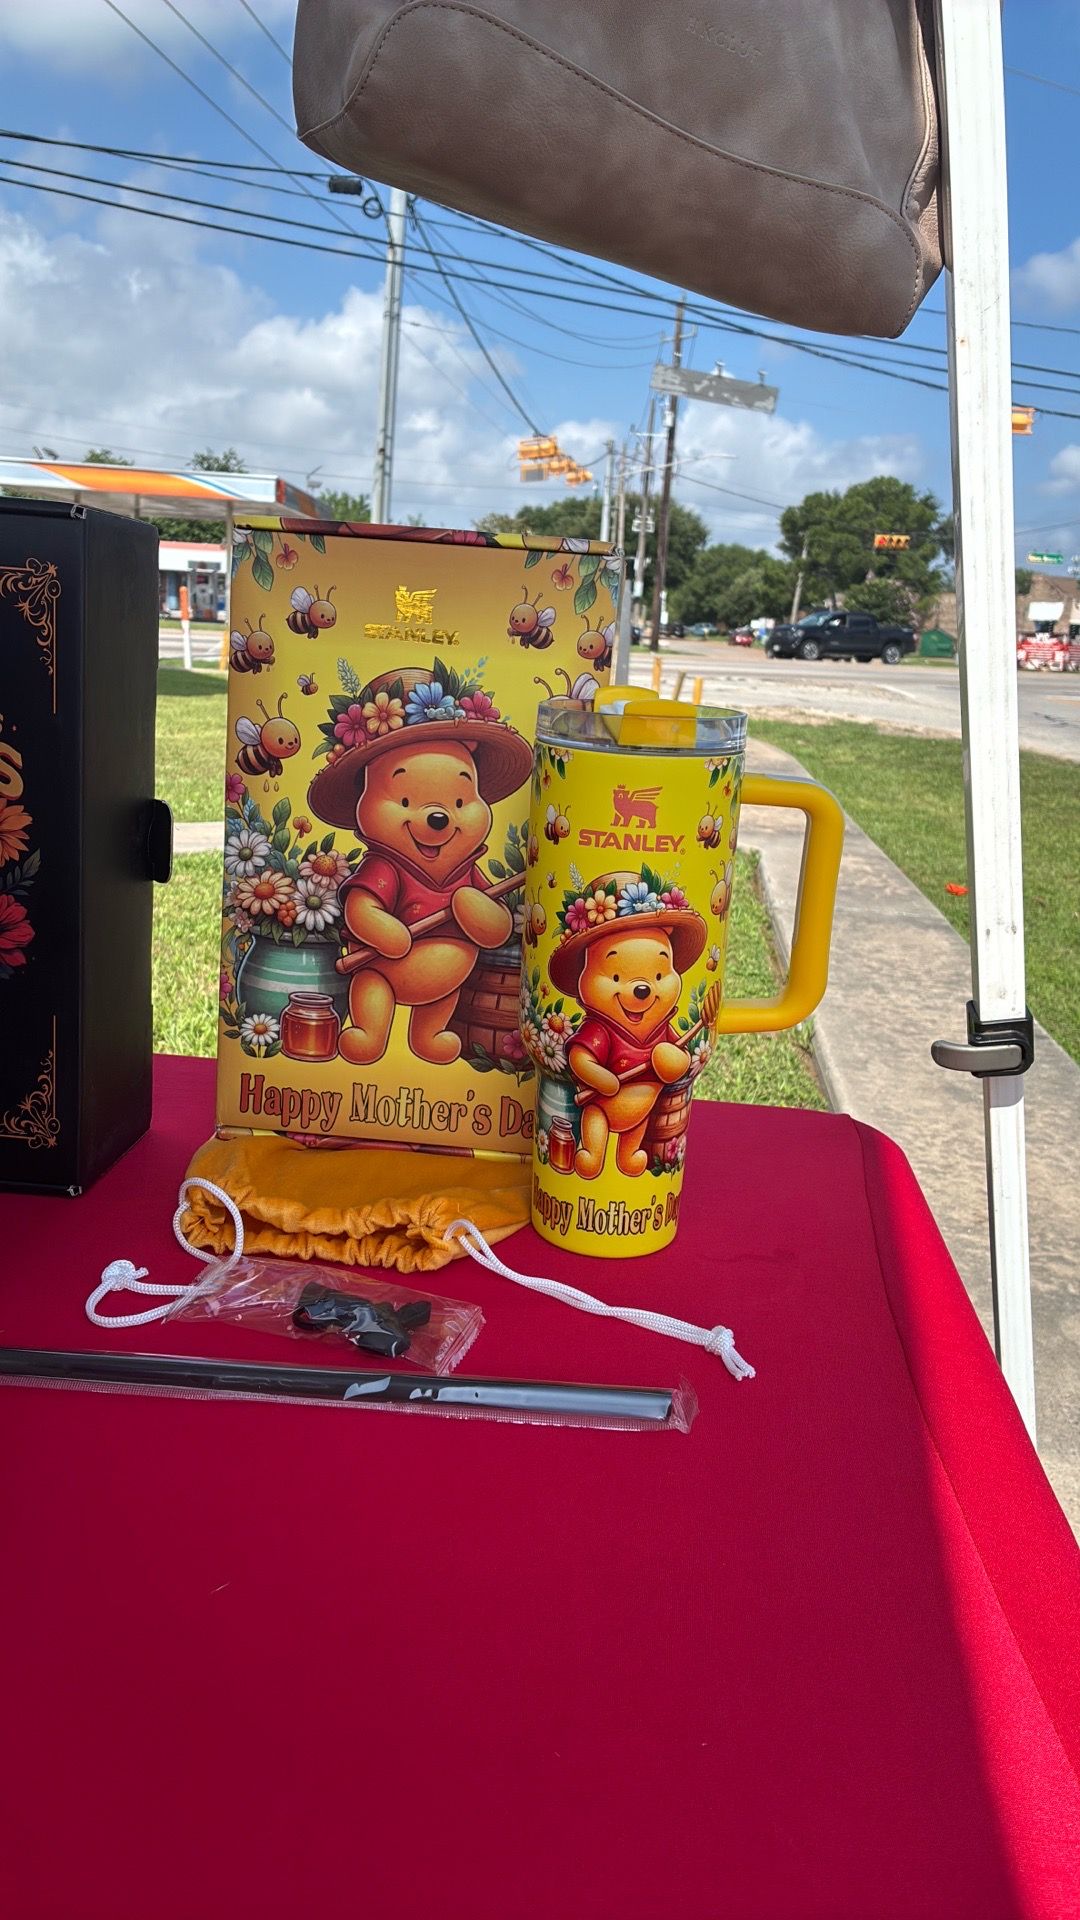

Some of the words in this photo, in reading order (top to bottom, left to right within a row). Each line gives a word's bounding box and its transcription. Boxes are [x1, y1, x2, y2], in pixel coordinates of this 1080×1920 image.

[239, 1072, 343, 1132] Happy
[349, 1082, 493, 1136] Mother's
[499, 1095, 535, 1140] Da
[576, 1194, 664, 1236] Mother's
